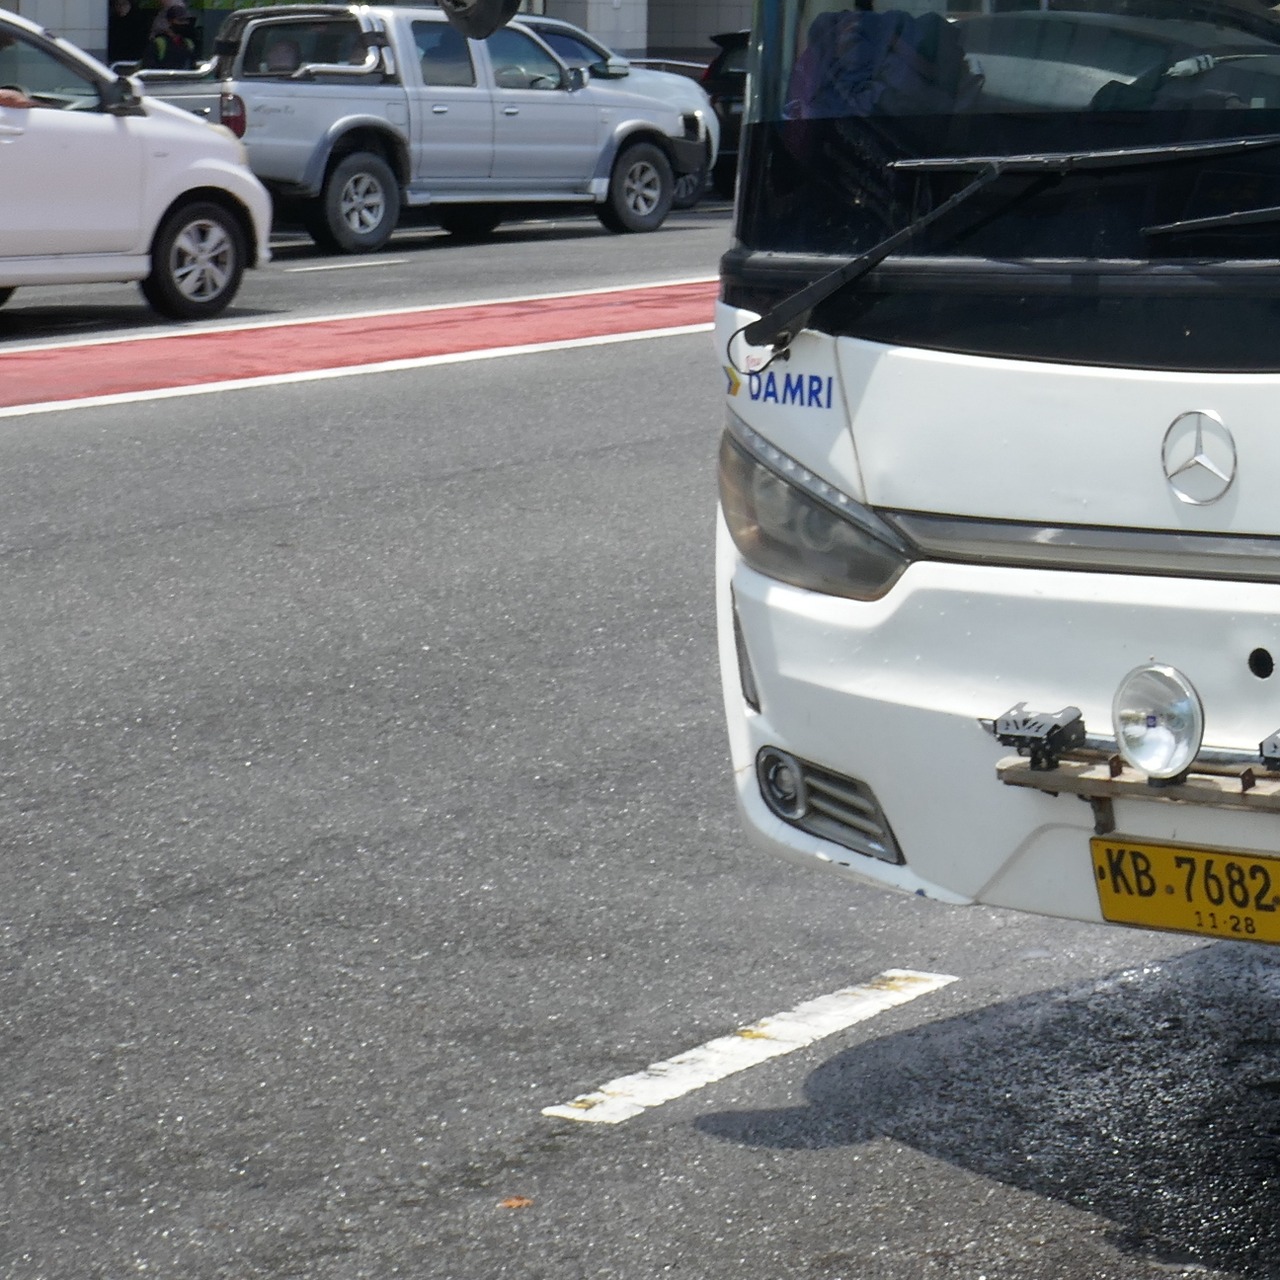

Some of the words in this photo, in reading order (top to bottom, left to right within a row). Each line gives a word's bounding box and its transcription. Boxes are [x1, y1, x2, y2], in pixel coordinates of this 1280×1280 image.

[748, 370, 833, 409] DAMRI
[1105, 847, 1157, 897] KB
[1174, 856, 1277, 912] 7682
